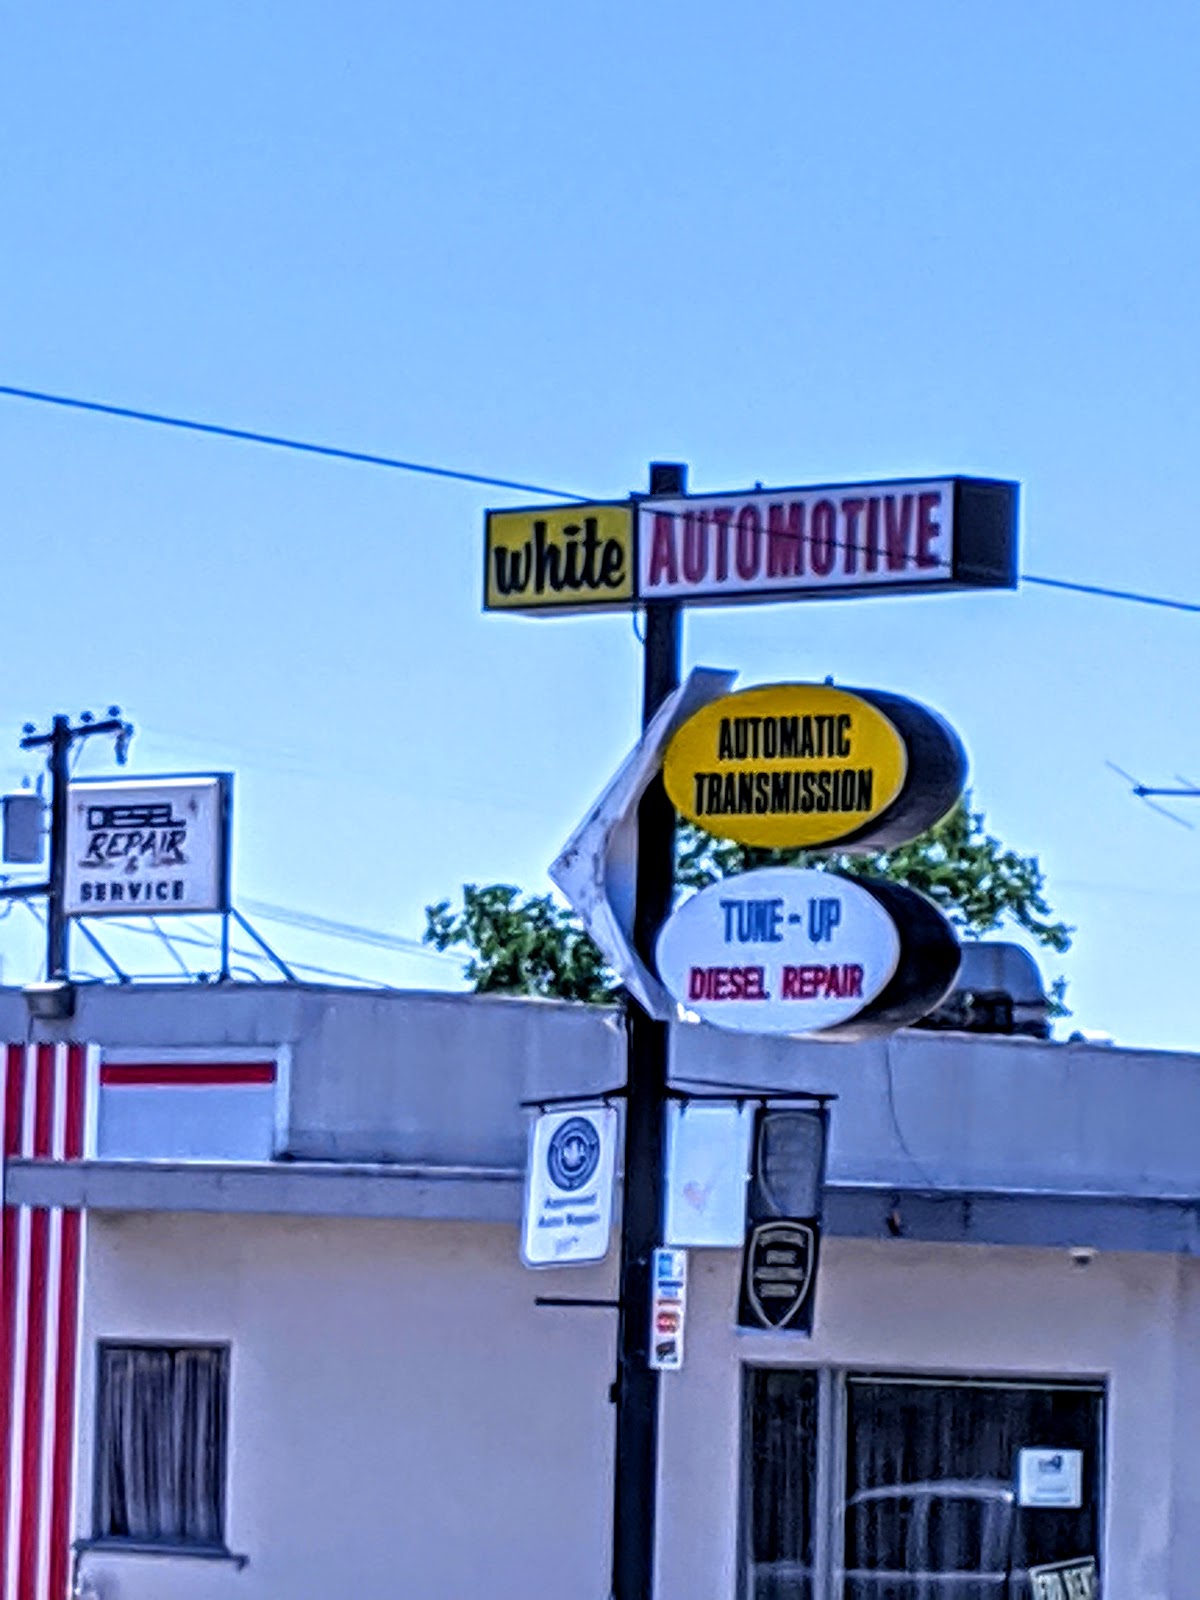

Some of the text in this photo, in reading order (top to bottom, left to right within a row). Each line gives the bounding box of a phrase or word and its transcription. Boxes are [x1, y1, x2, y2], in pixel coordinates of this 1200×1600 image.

[494, 492, 941, 595] white AUTOMOTIVE
[719, 715, 851, 760] AUTOMATIC
[693, 769, 873, 816] TRANSMISSION
[87, 804, 187, 830] DIESEL
[84, 830, 187, 865] REPAIR
[80, 880, 184, 901] SERVICE
[689, 964, 864, 1001] DIESEL REPAIR
